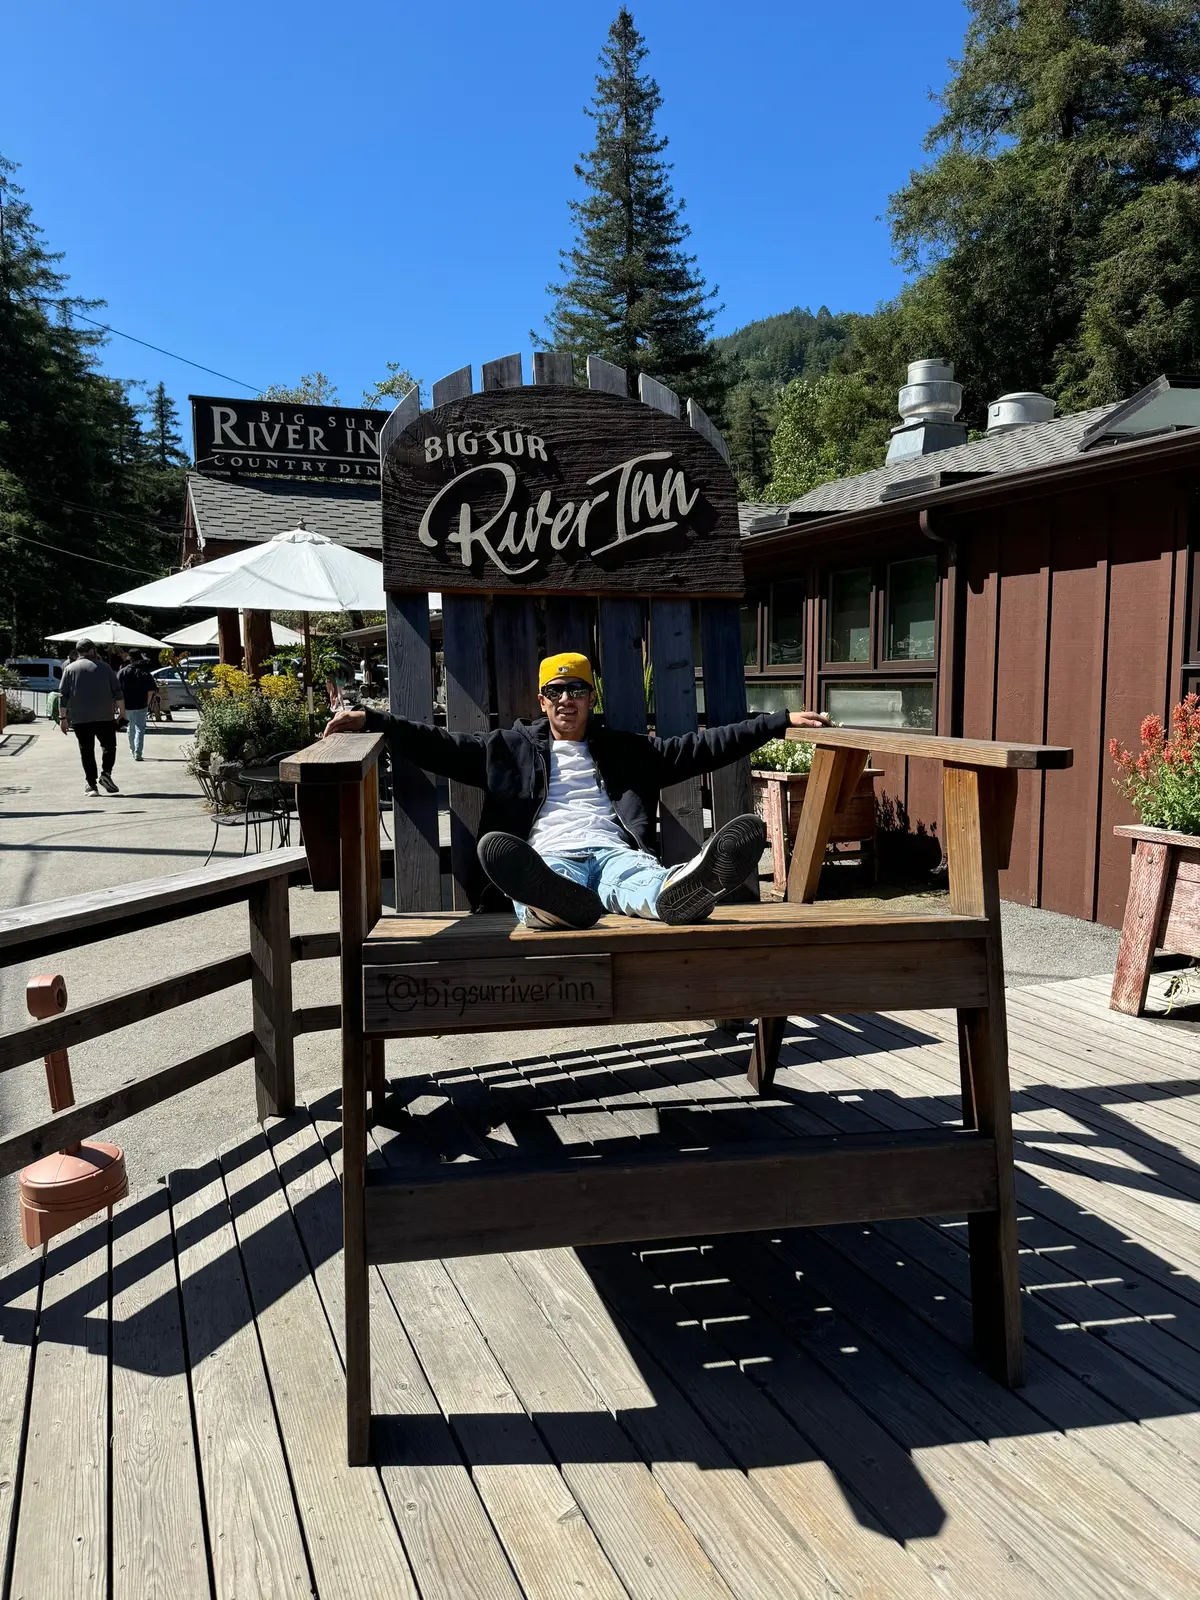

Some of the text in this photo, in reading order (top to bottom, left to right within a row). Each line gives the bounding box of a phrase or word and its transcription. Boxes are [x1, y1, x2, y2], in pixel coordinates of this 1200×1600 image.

[210, 405, 330, 452] RIVER
[261, 411, 375, 431] BIG SUR
[214, 457, 327, 472] COUNTRY
[424, 430, 548, 463] BIG SUR
[418, 451, 700, 575] River Inn
[386, 973, 595, 1016] @bigsurriverinn
